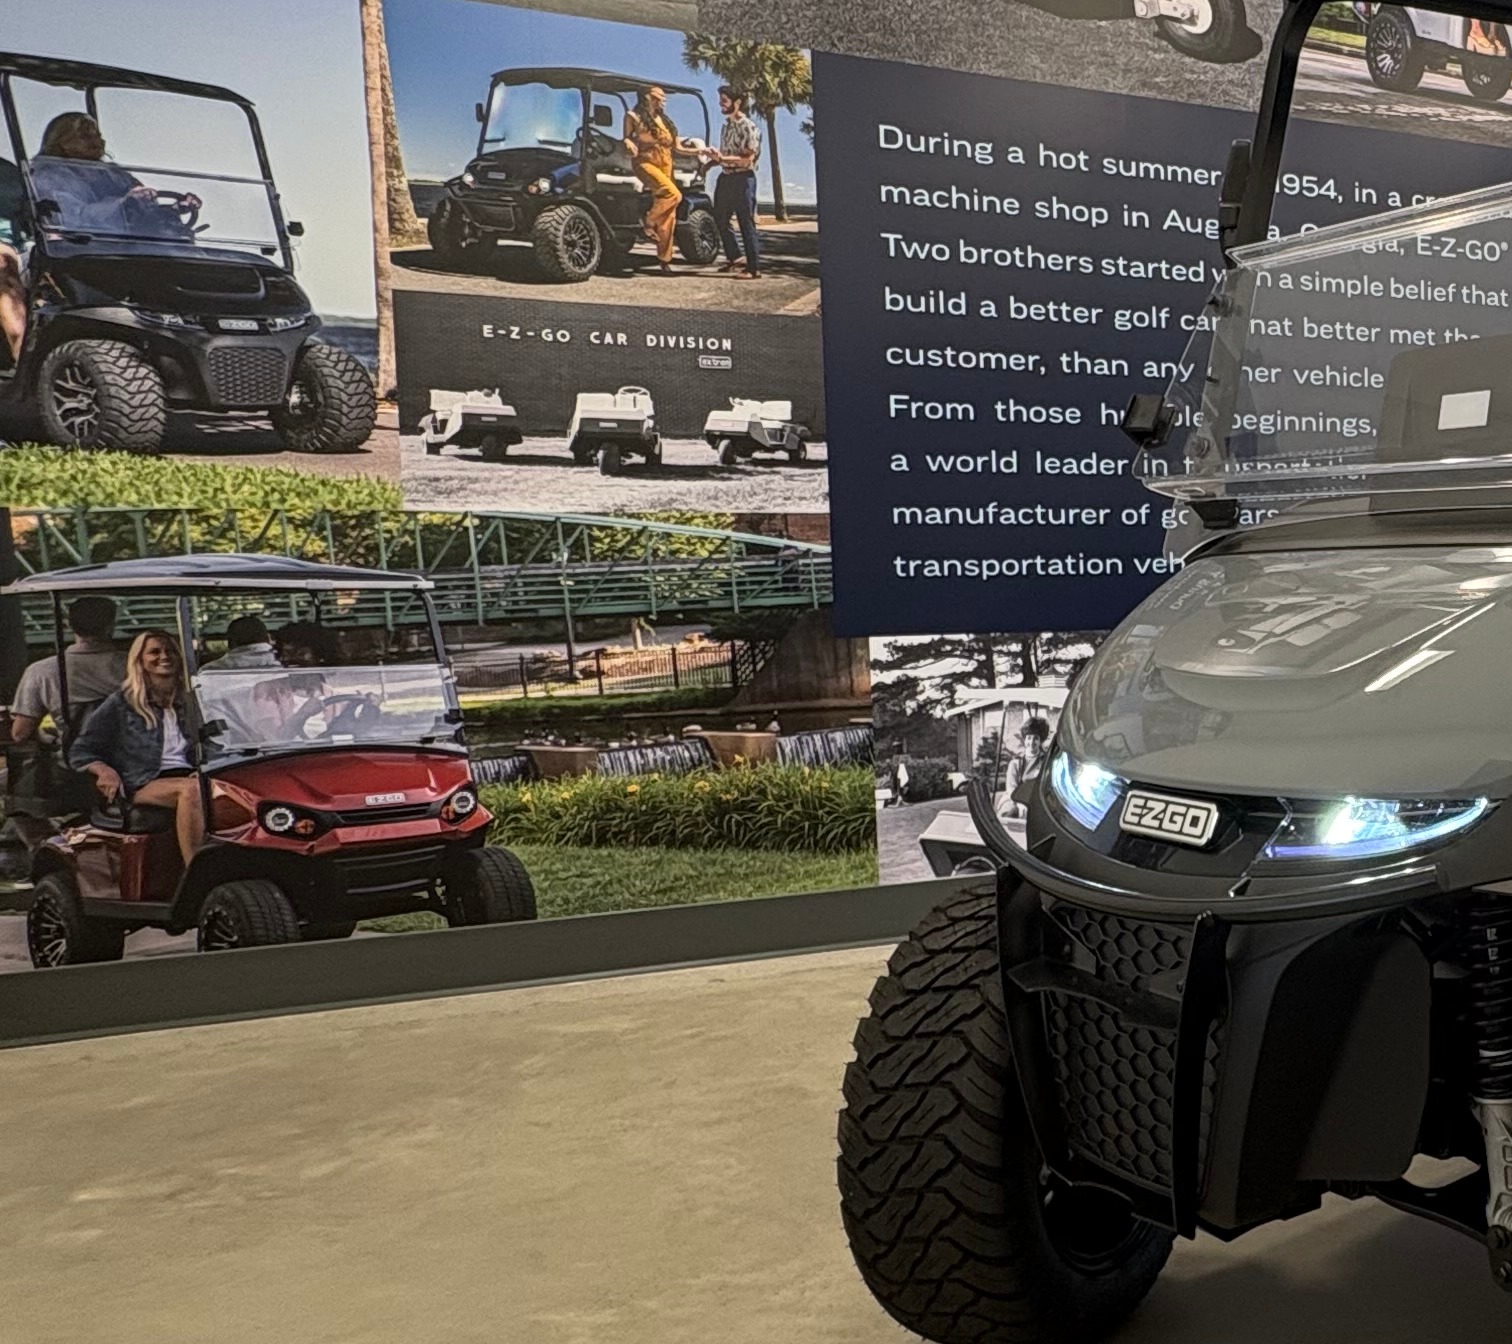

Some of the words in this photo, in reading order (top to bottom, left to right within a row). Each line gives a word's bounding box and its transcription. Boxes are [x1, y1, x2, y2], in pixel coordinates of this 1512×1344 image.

[878, 124, 994, 165] During
[1007, 146, 1025, 165] a
[1039, 143, 1089, 172] hot
[1103, 157, 1222, 186] summer
[1275, 173, 1343, 203] 1954,
[1354, 181, 1377, 205] in
[1387, 191, 1402, 207] a
[880, 183, 1020, 216] machine
[1034, 196, 1109, 228] shop
[1123, 204, 1149, 229] in
[880, 232, 950, 262] Two
[959, 239, 1094, 273] brothers
[1101, 256, 1205, 283] started
[1279, 273, 1294, 289] a
[1300, 271, 1384, 298] simple
[1390, 277, 1456, 302] belief
[1461, 284, 1509, 308] that
[884, 286, 967, 316] build
[979, 299, 998, 318] a
[1009, 295, 1103, 325] better
[1114, 306, 1170, 331] golf
[1180, 314, 1221, 332] car
[1303, 316, 1381, 343] better
[1389, 327, 1436, 346] met
[482, 324, 571, 343] E-Z-GO
[589, 330, 628, 346] CAR
[646, 334, 732, 351] DIVISION
[886, 346, 1046, 375] customer,
[1060, 351, 1129, 377] than
[1143, 359, 1195, 382] any
[1293, 365, 1385, 388] vehicle
[889, 394, 975, 421] From
[994, 398, 1082, 425] those
[890, 454, 909, 473] a
[925, 450, 1018, 474] world
[1036, 450, 1130, 475] leader
[1142, 453, 1168, 476] in
[892, 502, 1111, 526] manufacturer
[1121, 503, 1150, 526] of
[893, 553, 1123, 581] transportation
[1124, 797, 1208, 836] EZGO
